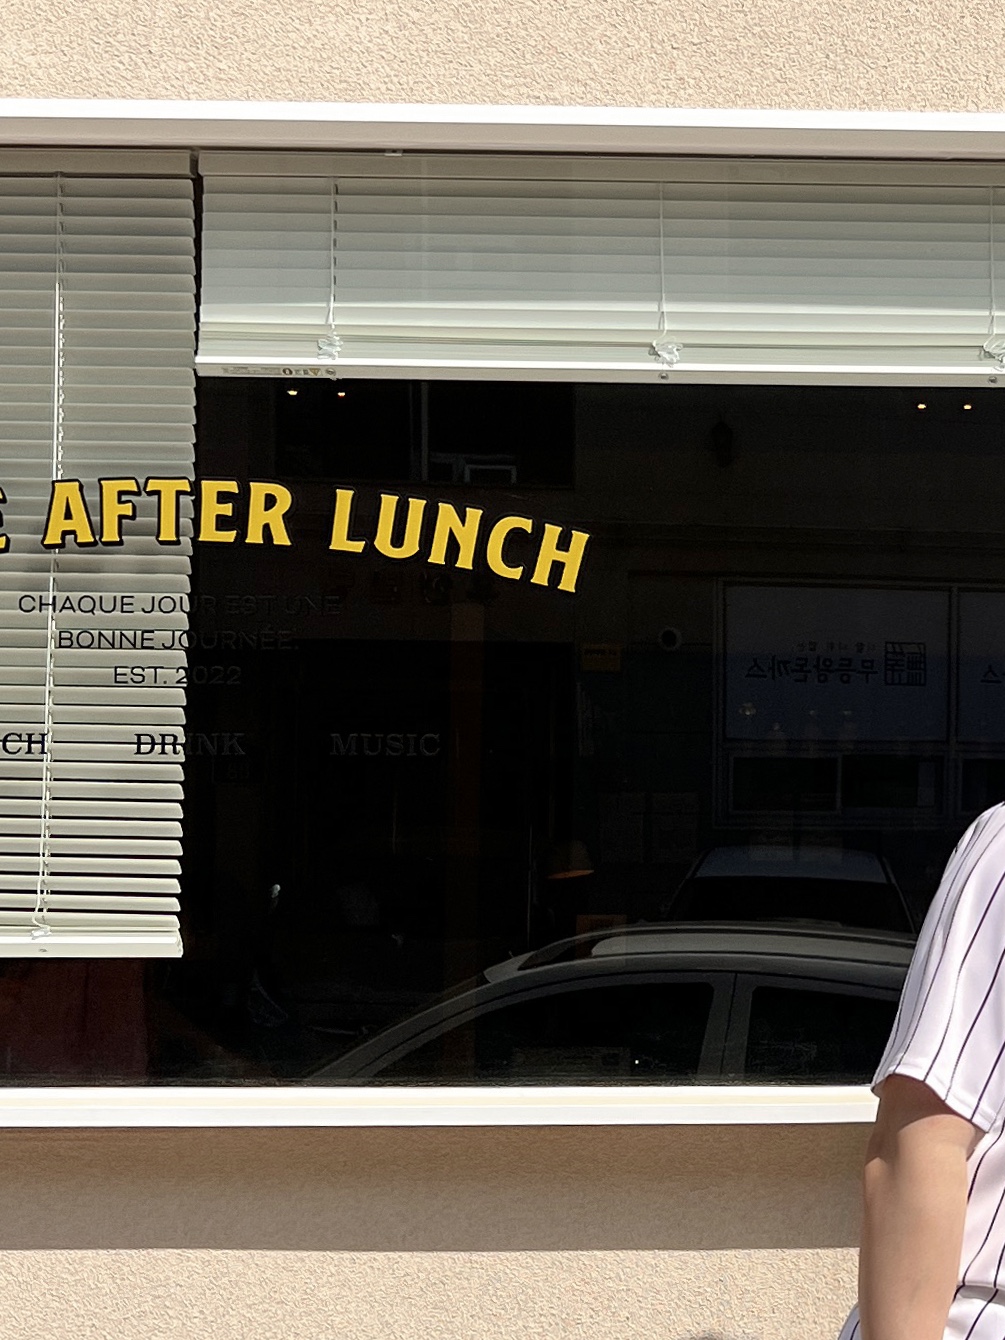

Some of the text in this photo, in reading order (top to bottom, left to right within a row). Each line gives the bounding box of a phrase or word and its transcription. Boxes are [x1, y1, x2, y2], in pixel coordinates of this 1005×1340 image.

[42, 478, 294, 548] AFTER
[328, 487, 591, 594] LUNCH
[18, 594, 341, 615] CHAQUE JOUR EST UNE
[58, 630, 156, 650] BONNE
[113, 664, 242, 685] EST. 2022
[133, 732, 246, 756] DRINK
[329, 732, 442, 757] MUSIC
